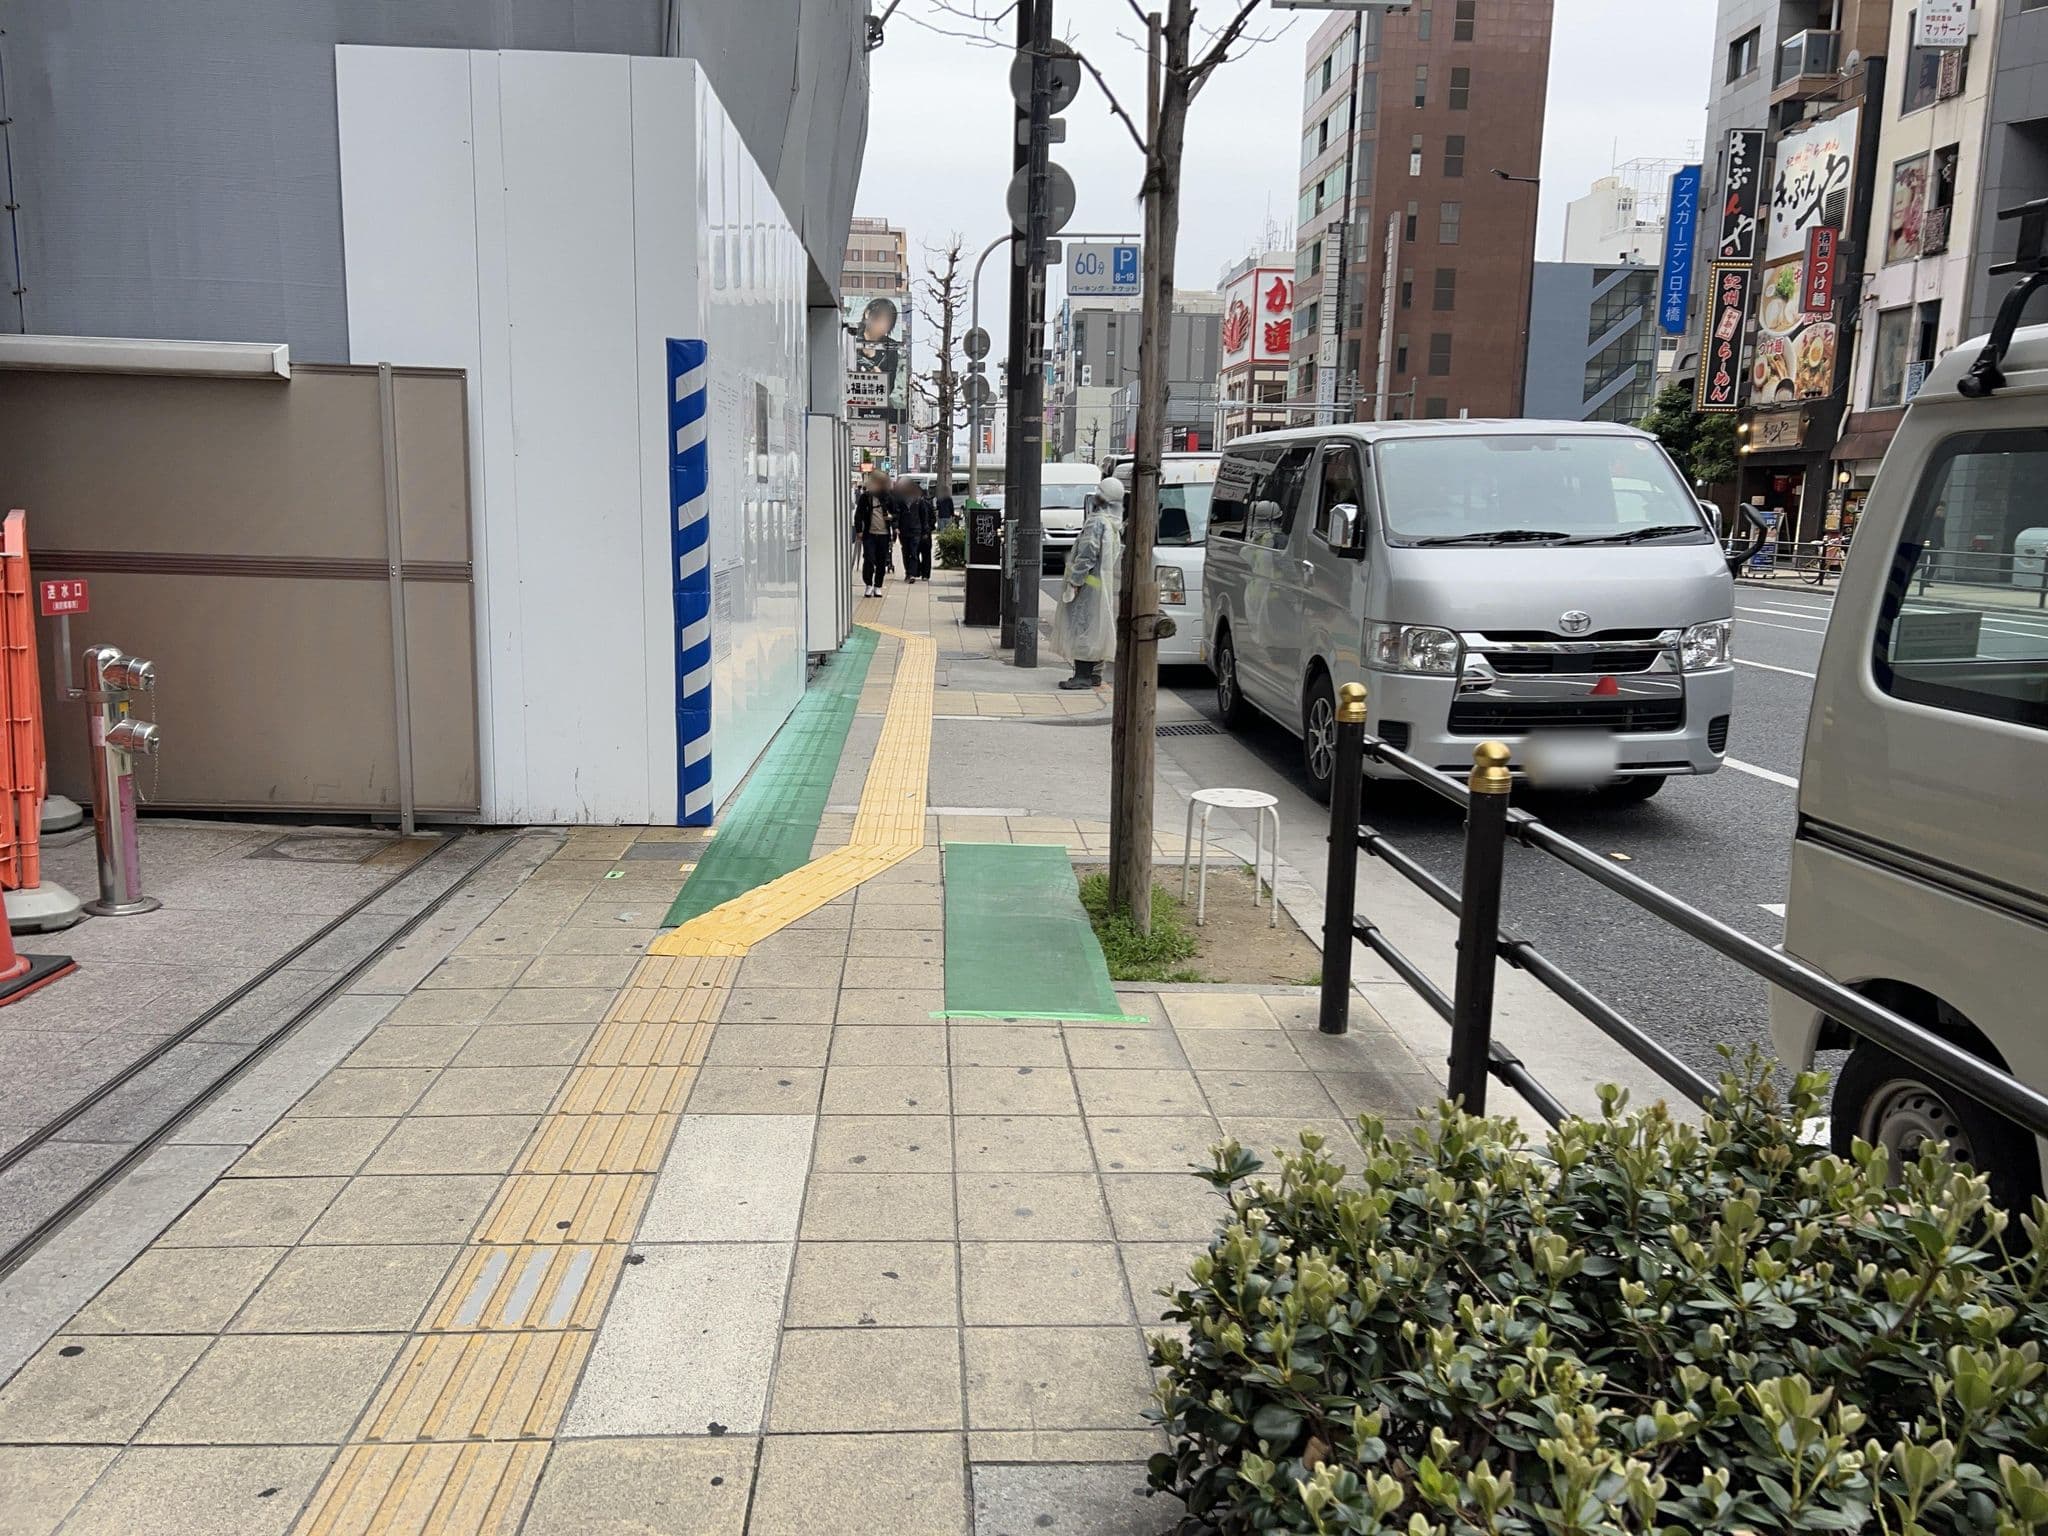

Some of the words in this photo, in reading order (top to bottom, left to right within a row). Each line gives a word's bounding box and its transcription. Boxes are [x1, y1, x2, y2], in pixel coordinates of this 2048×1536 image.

[1925, 23, 1965, 36] マッサージ
[1120, 249, 1133, 271] P
[1665, 177, 1693, 322] アズガーデン日本橋
[1075, 252, 1105, 275] 60分
[47, 583, 82, 600] 送水口
